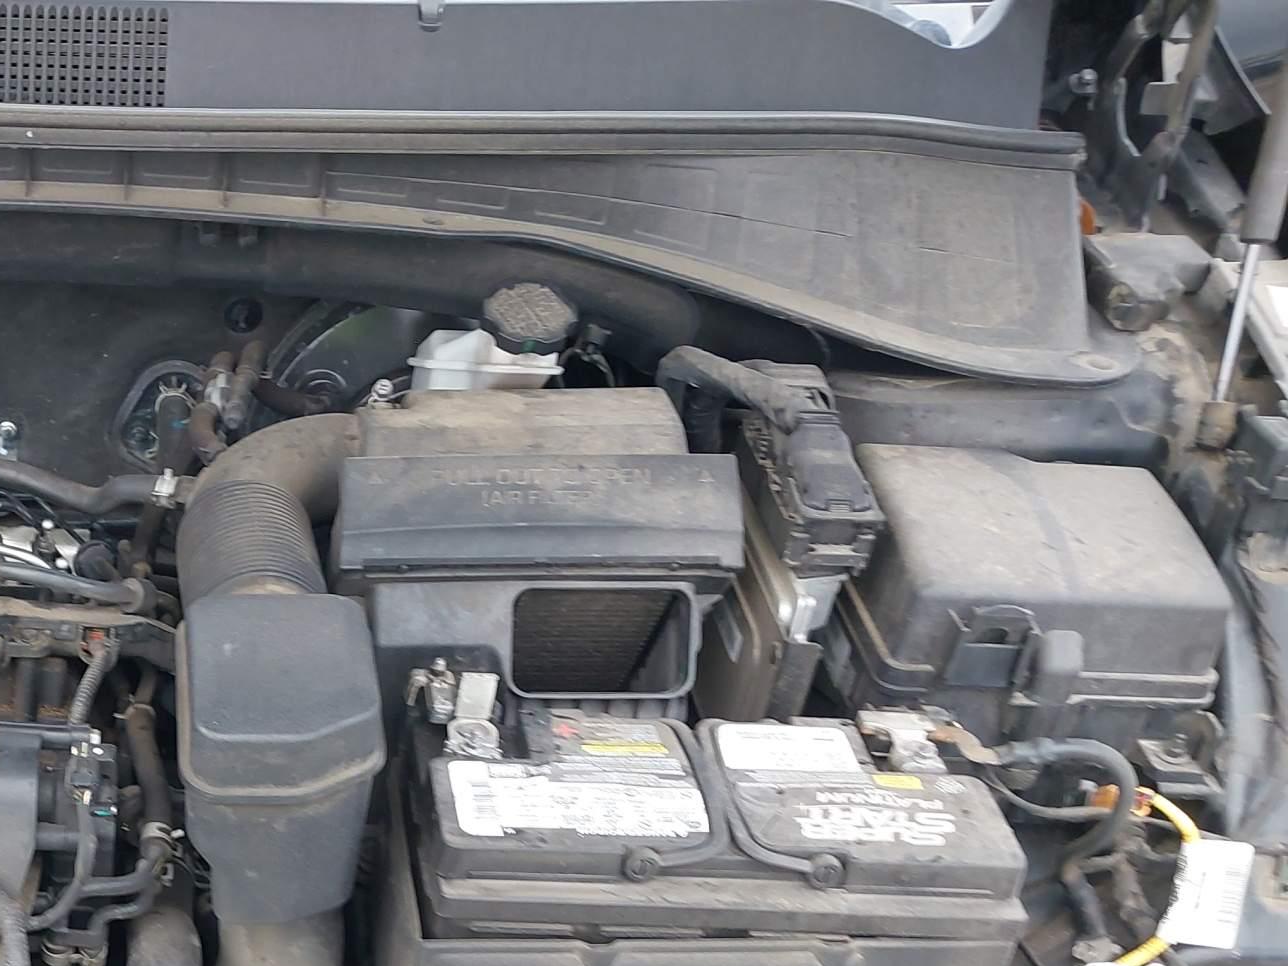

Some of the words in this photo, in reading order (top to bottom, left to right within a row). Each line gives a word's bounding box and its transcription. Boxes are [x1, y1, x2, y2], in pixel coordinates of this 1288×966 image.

[431, 469, 491, 486] PULL
[496, 468, 545, 485] OUT
[585, 468, 651, 486] OPEN
[814, 791, 944, 810] PLATINUM
[792, 804, 956, 833] START
[798, 821, 946, 847] SUPER
